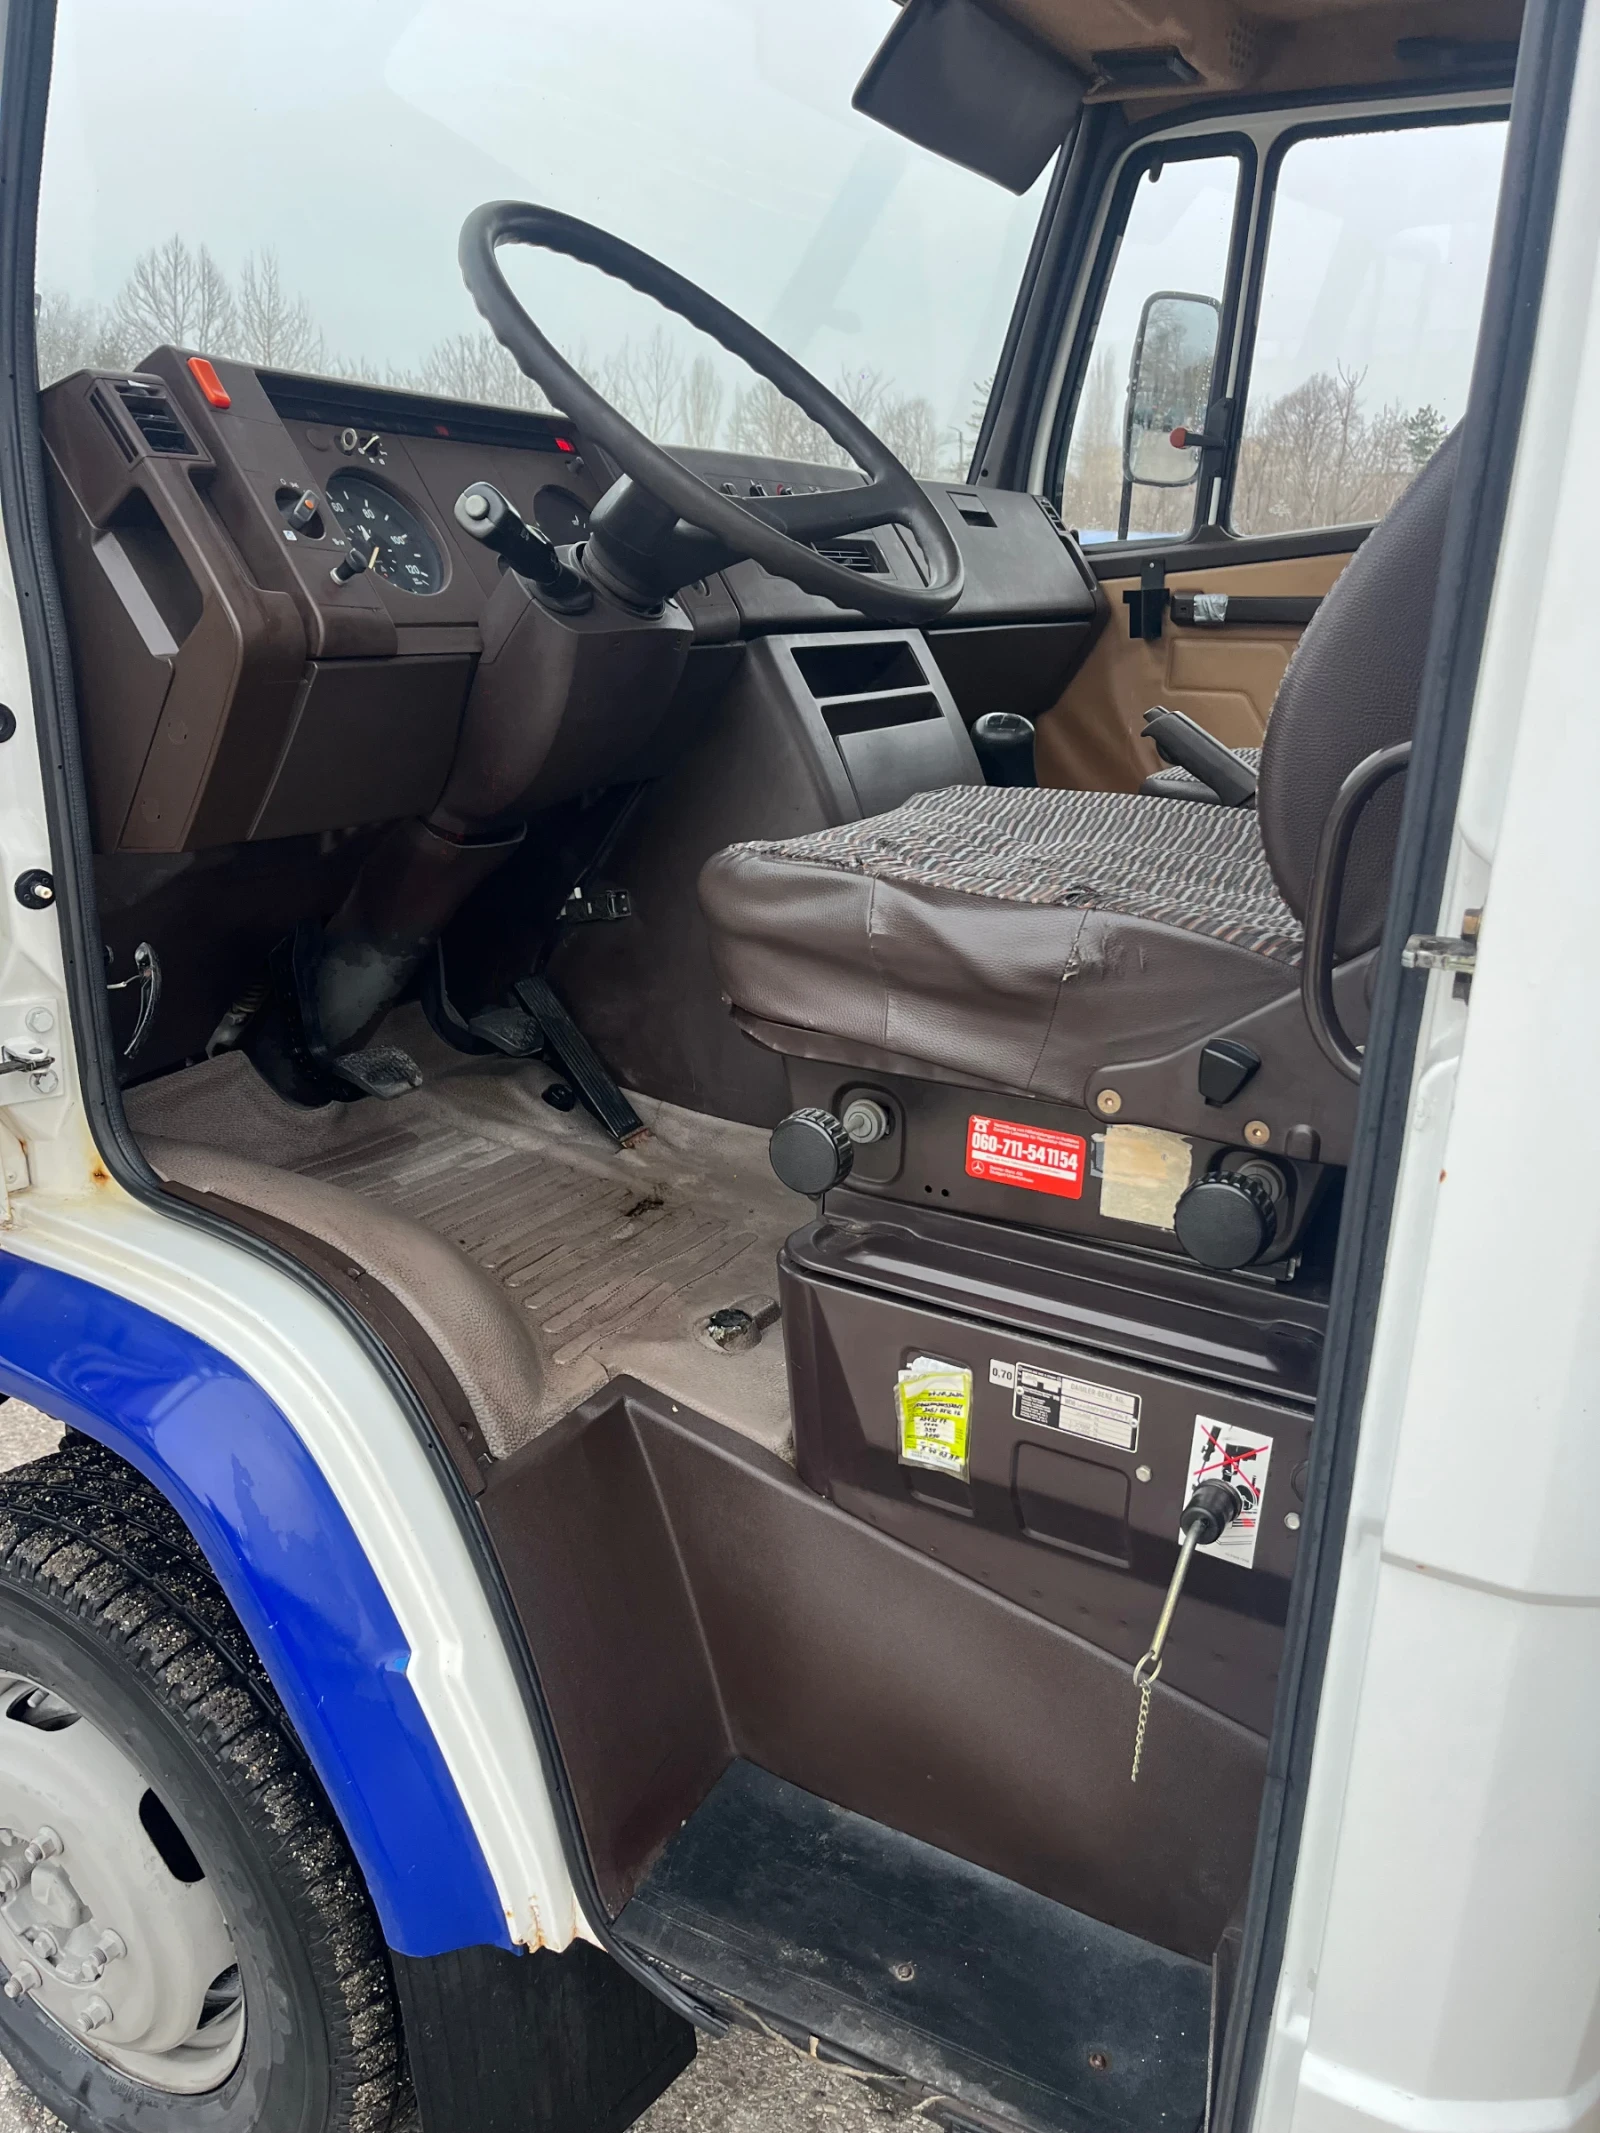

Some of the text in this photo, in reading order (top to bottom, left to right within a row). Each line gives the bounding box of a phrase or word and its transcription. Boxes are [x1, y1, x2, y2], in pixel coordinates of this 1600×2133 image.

[331, 502, 344, 513] 60
[362, 508, 375, 519] 80
[390, 535, 406, 545] 100
[405, 564, 420, 575] 120
[971, 1131, 1078, 1171] 060-711-541154
